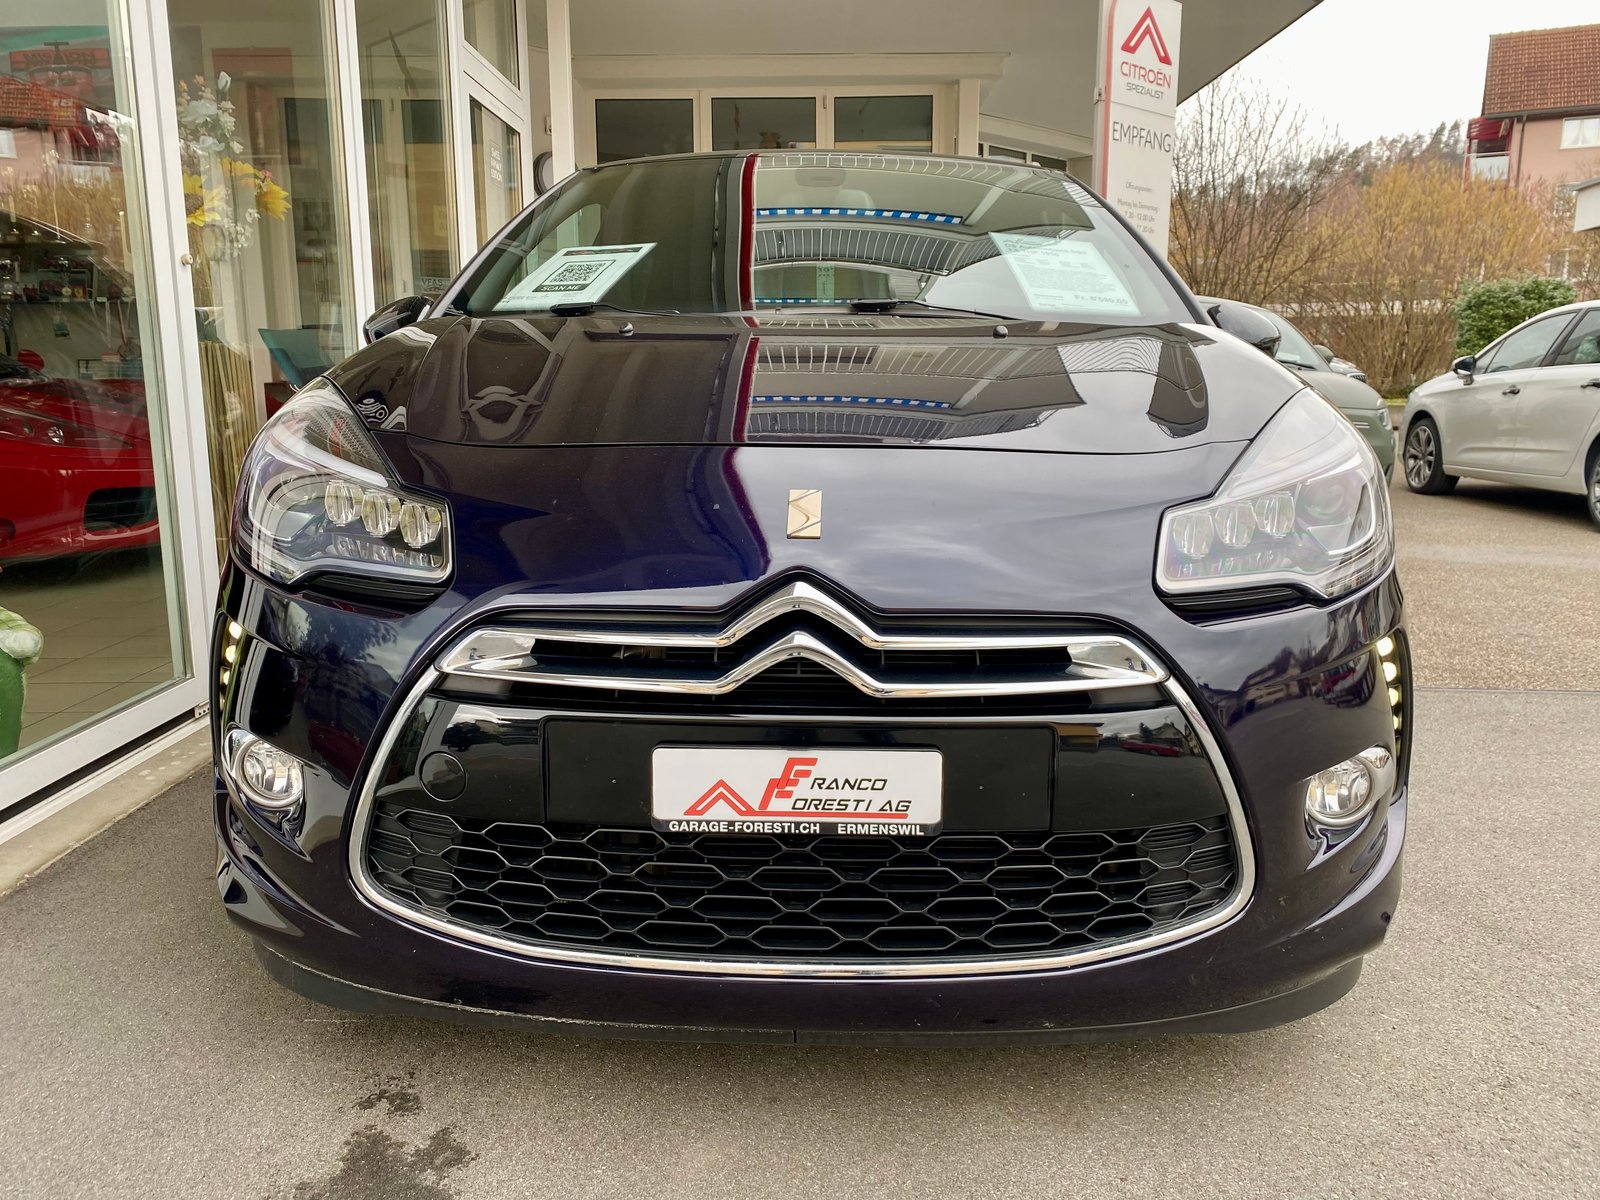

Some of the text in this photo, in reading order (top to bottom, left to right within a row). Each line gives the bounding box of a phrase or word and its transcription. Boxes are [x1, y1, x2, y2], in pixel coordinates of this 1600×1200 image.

[1120, 61, 1172, 88] CITROËN
[1126, 82, 1164, 99] SPEZIALIST
[1112, 121, 1172, 153] EMPFANG
[777, 757, 888, 791] FRANCO
[878, 799, 912, 812] AG
[668, 820, 925, 836] GARAGE-FORESTI.CH ERMENSWIL
